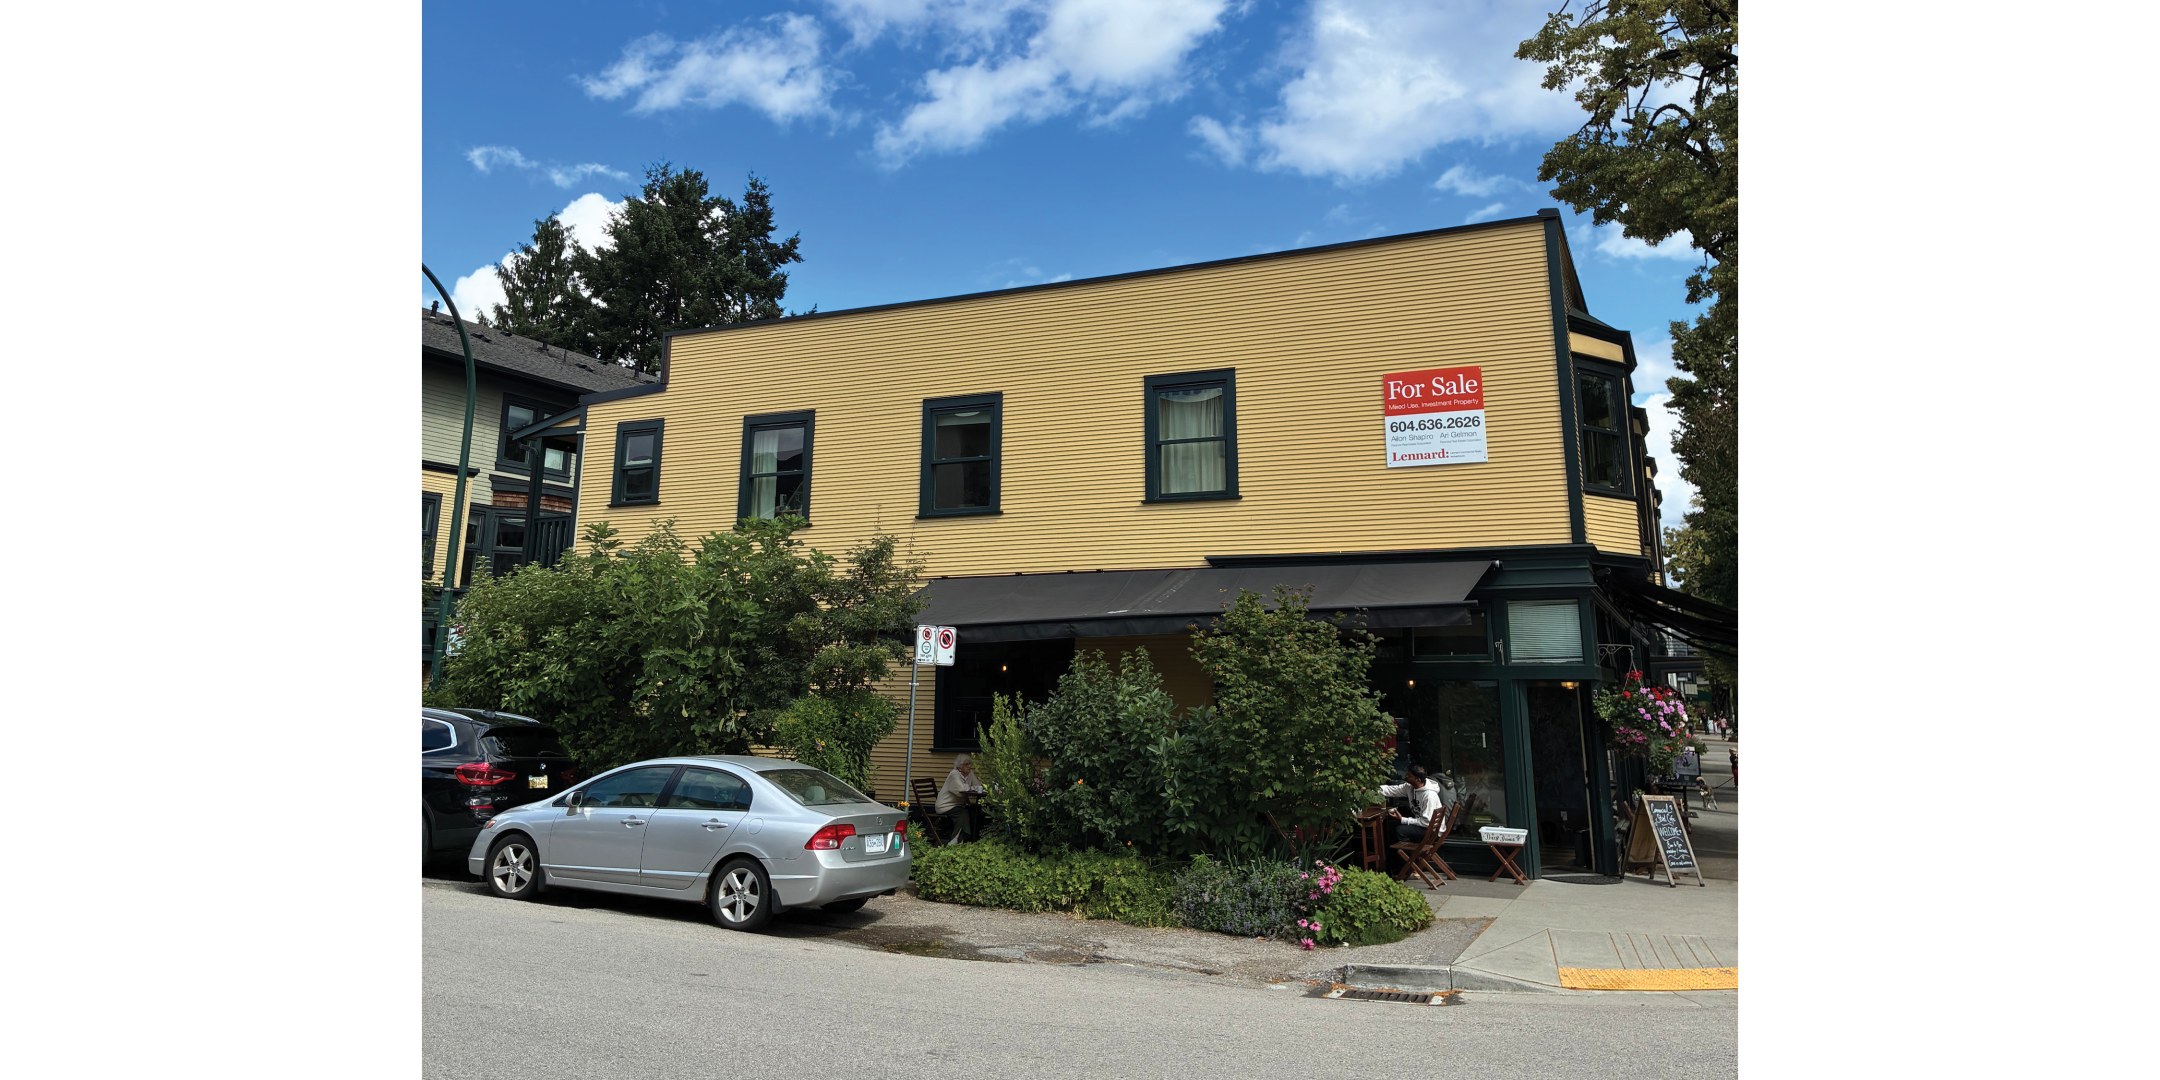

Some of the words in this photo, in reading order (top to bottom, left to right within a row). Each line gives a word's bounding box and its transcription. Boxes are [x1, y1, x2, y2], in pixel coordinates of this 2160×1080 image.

[1388, 380, 1425, 400] For
[1431, 374, 1478, 396] Sale
[1421, 400, 1452, 408] Investment
[1390, 416, 1480, 433] 604.636.2626
[1409, 433, 1434, 441] Shapiro
